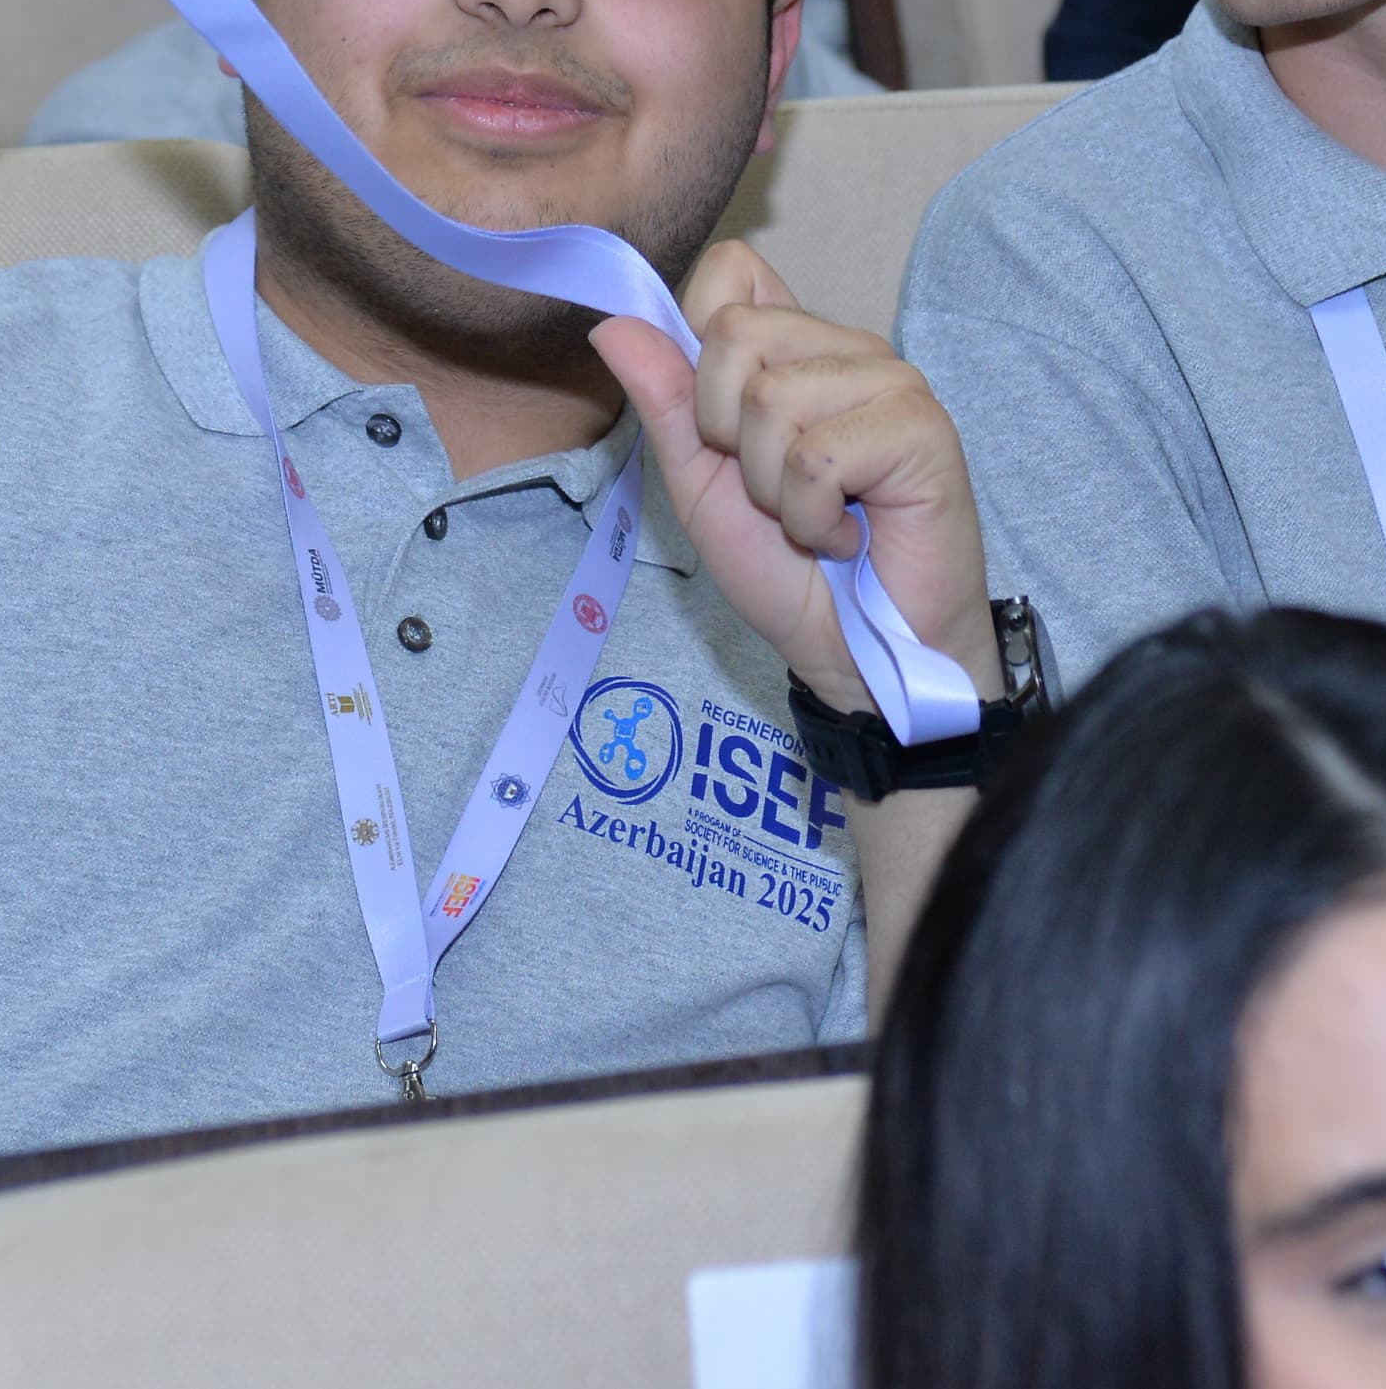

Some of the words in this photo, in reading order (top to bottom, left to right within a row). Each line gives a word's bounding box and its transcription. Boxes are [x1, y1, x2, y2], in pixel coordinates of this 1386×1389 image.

[700, 698, 806, 759] REGENERON
[694, 809, 732, 833] PROGRAM
[732, 827, 742, 837] OF
[557, 793, 746, 898] Azerbaijan
[756, 872, 836, 934] 2025
[684, 819, 722, 847] SOCIETY
[723, 837, 740, 856] FOR
[742, 846, 779, 872] SCIENCE
[790, 866, 807, 884] THE
[809, 873, 843, 897] PUBLIC
